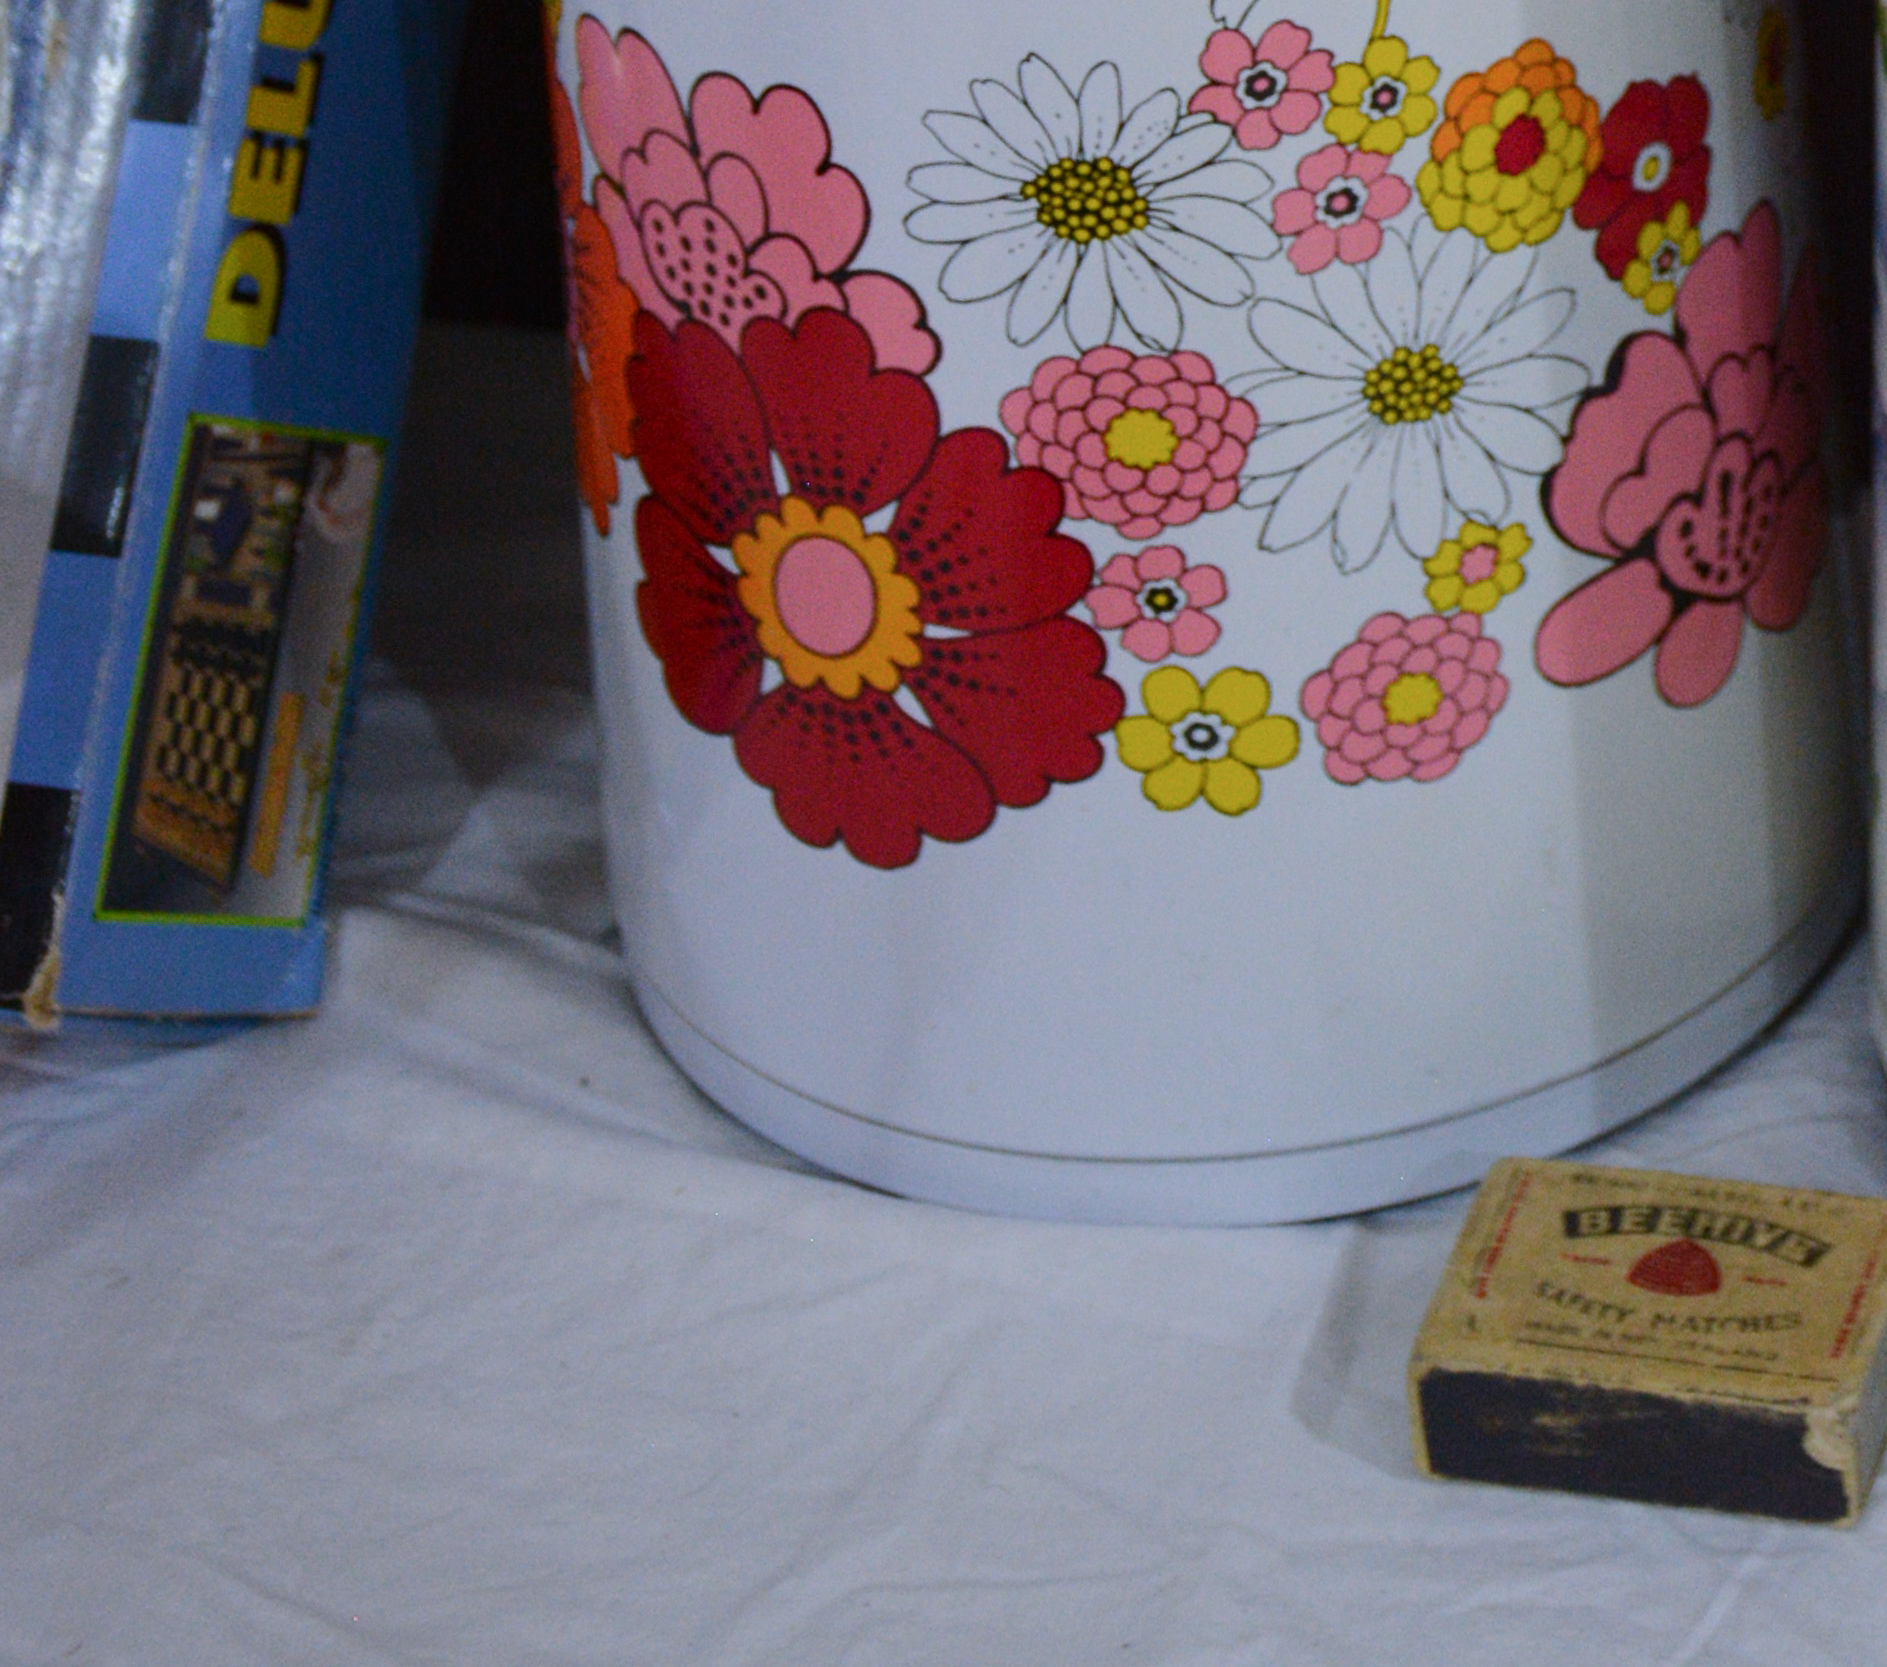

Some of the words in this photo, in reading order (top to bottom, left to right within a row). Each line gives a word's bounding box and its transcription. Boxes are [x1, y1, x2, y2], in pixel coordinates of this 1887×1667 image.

[1574, 1206, 1818, 1265] BEEHIVE
[1533, 1279, 1634, 1323] SAFETY
[1650, 1311, 1804, 1334] MATCHES
